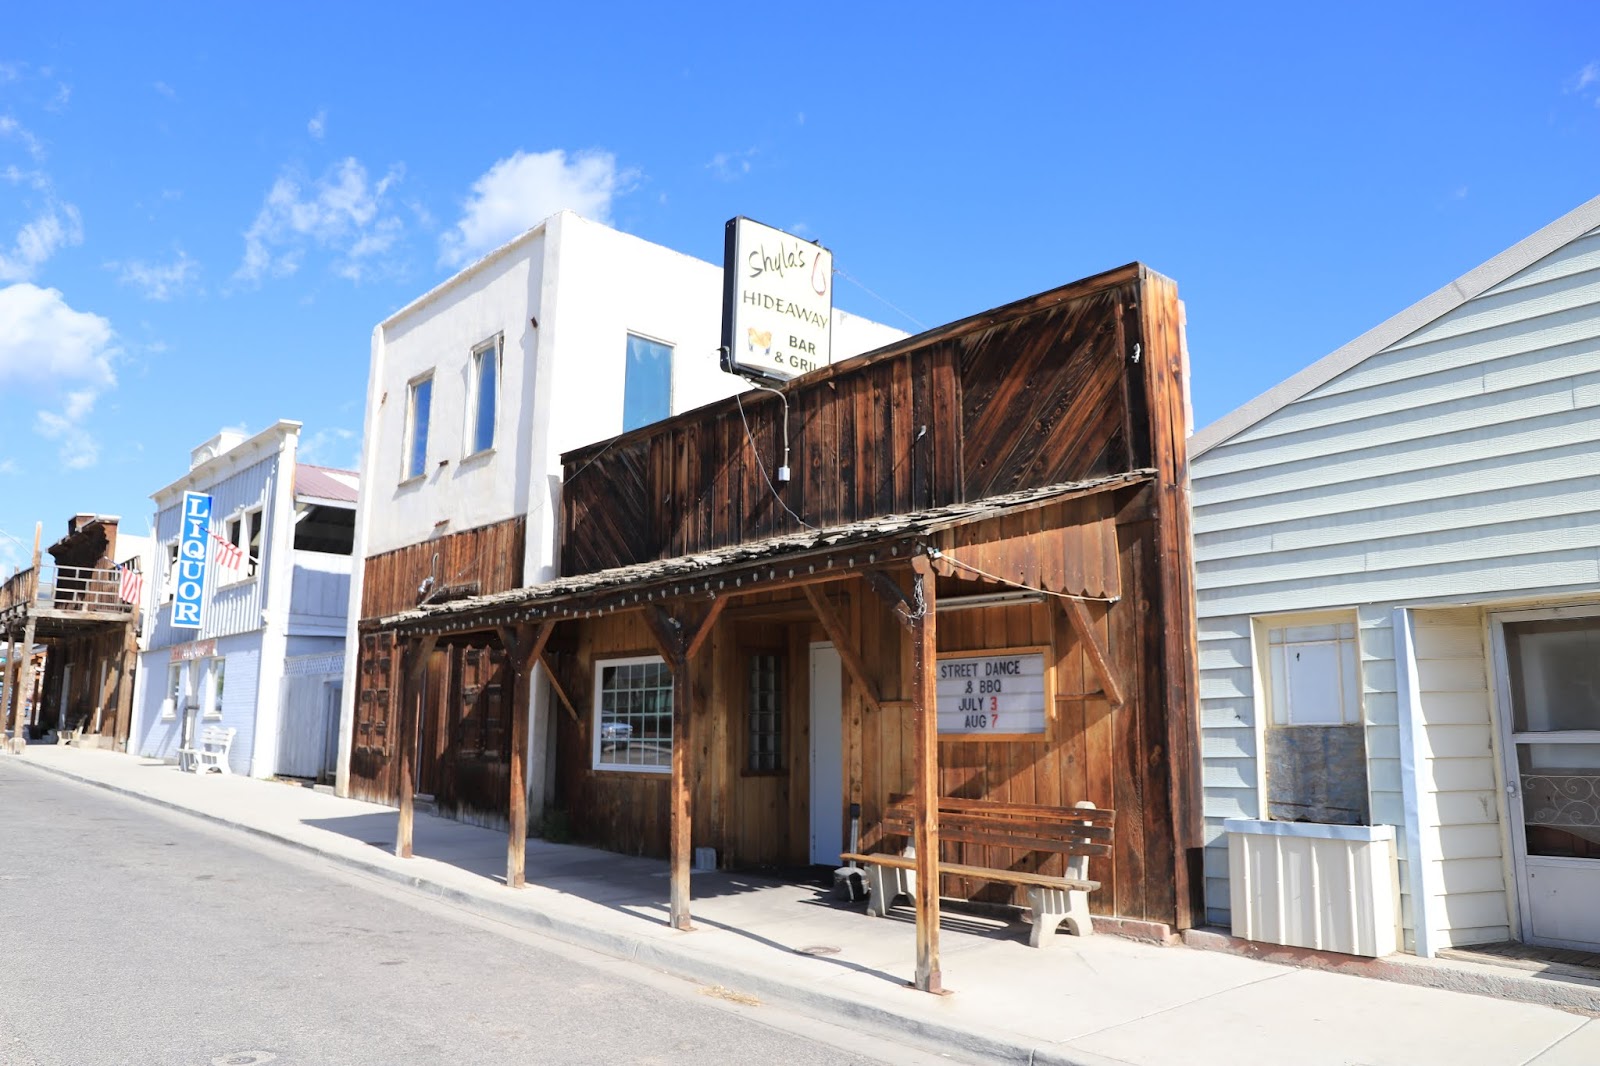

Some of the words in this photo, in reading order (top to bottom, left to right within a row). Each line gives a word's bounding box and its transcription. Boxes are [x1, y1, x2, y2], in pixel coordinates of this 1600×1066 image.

[749, 241, 806, 278] Shyla's
[743, 290, 828, 329] HIDEAWAY
[789, 335, 816, 355] BAR
[774, 351, 784, 364] &
[789, 355, 822, 373] GRI
[174, 498, 209, 622] LIQUOR
[941, 662, 979, 679] STREET
[985, 660, 1021, 676] DANCE
[965, 680, 973, 694] &
[980, 679, 1002, 694] BBQ
[958, 697, 984, 712] JULY
[990, 696, 998, 711] 3
[964, 714, 987, 729] AUG
[991, 714, 999, 729] 7
